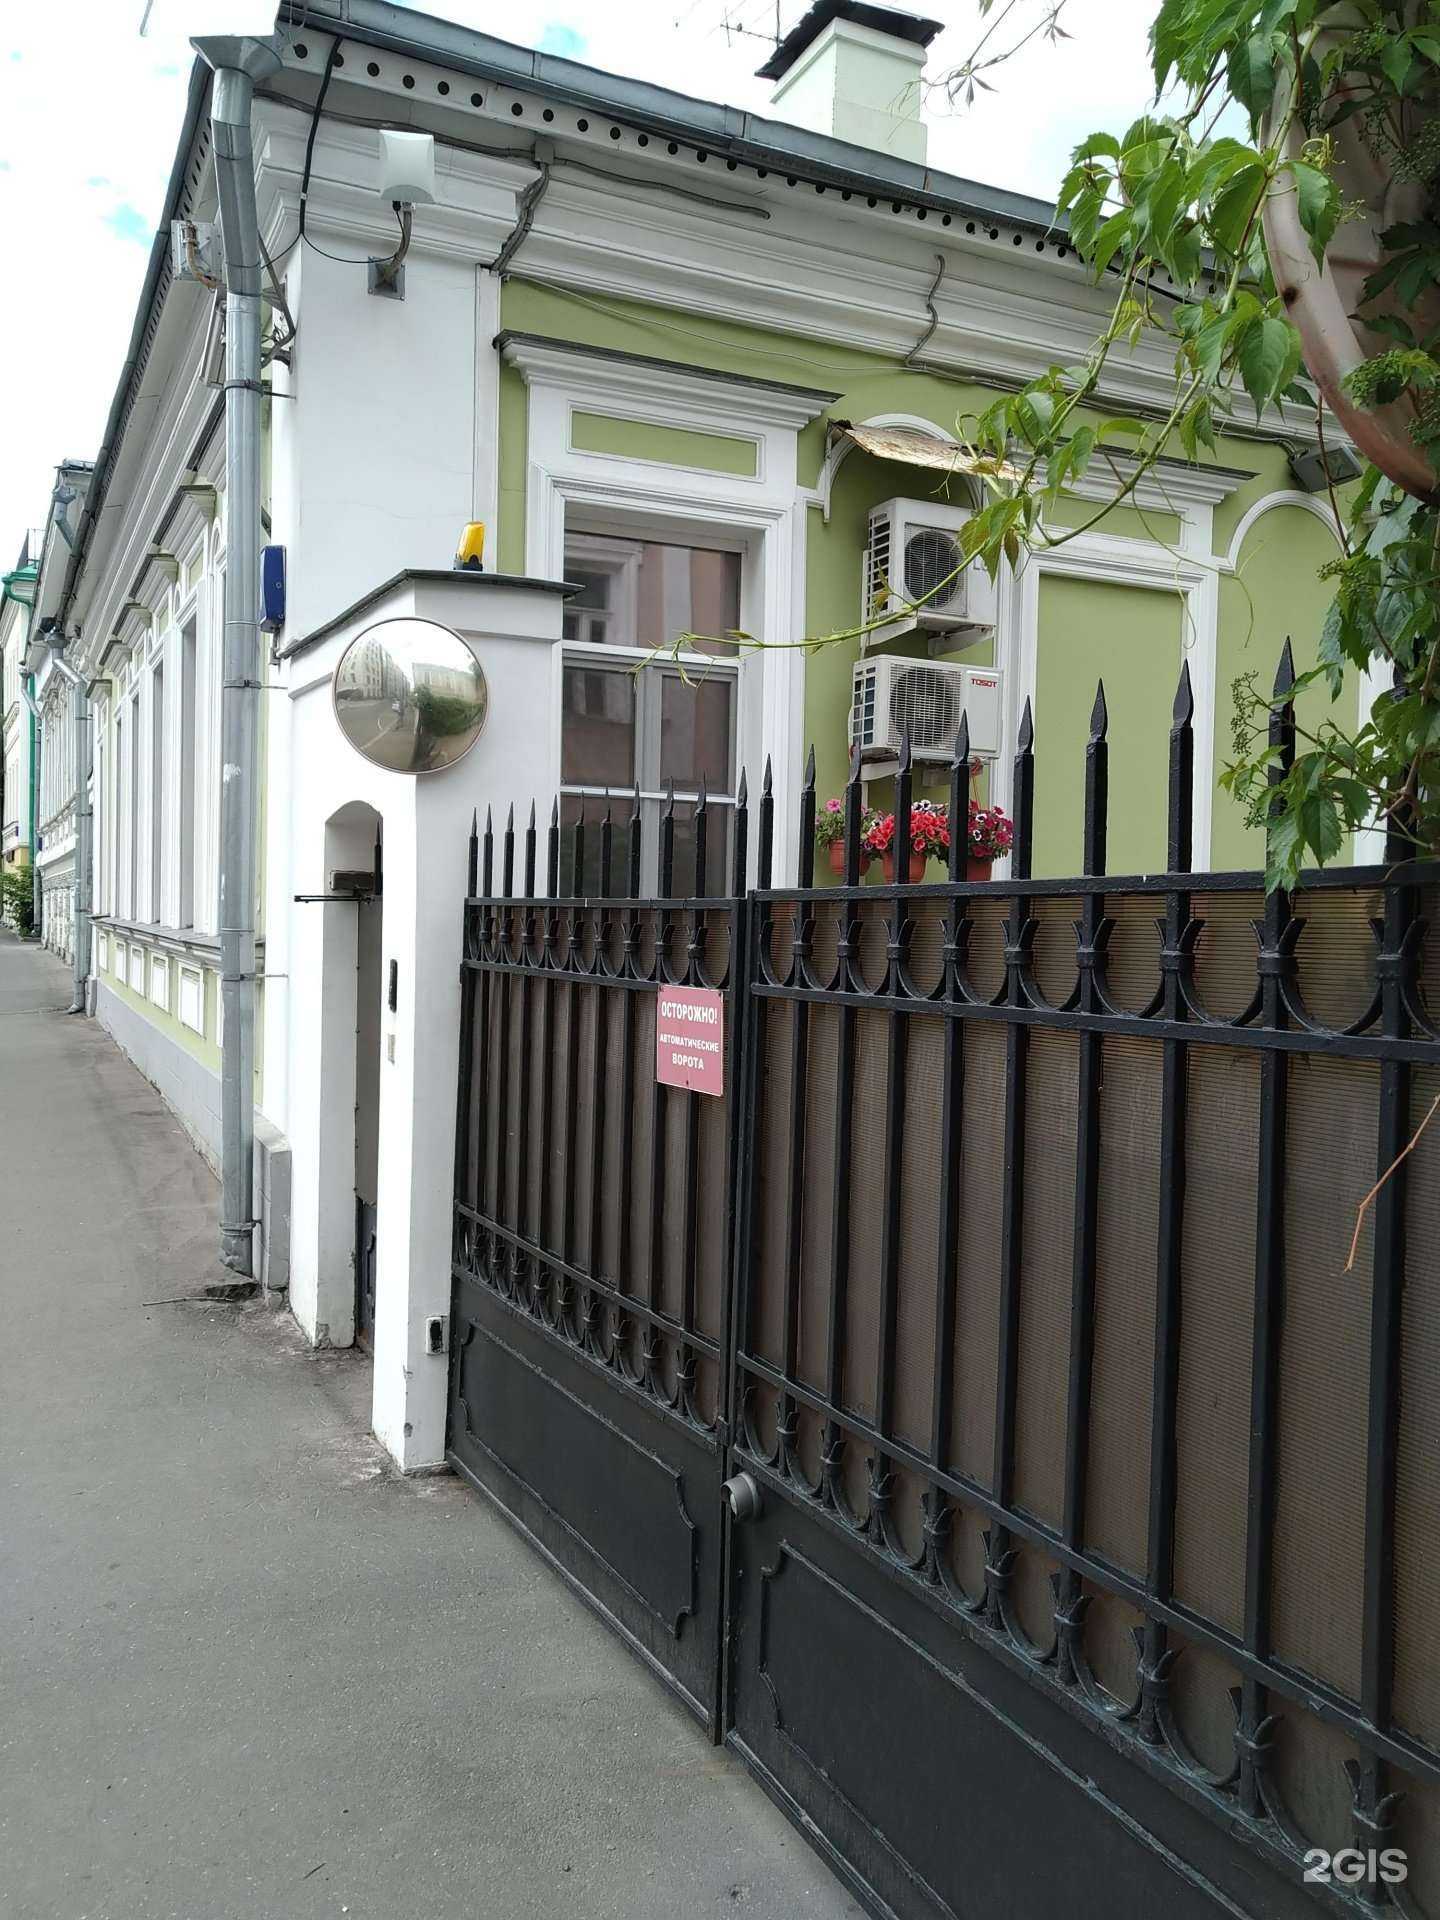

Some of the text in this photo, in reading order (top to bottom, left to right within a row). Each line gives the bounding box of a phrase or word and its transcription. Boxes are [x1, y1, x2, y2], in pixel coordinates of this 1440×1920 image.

[971, 678, 998, 688] TOSOT
[661, 1001, 718, 1025] ОСТОРОЖНО!
[660, 1033, 720, 1053] АВТОМАТИЧЕСКИЕ
[672, 1053, 704, 1070] ВОРОТА
